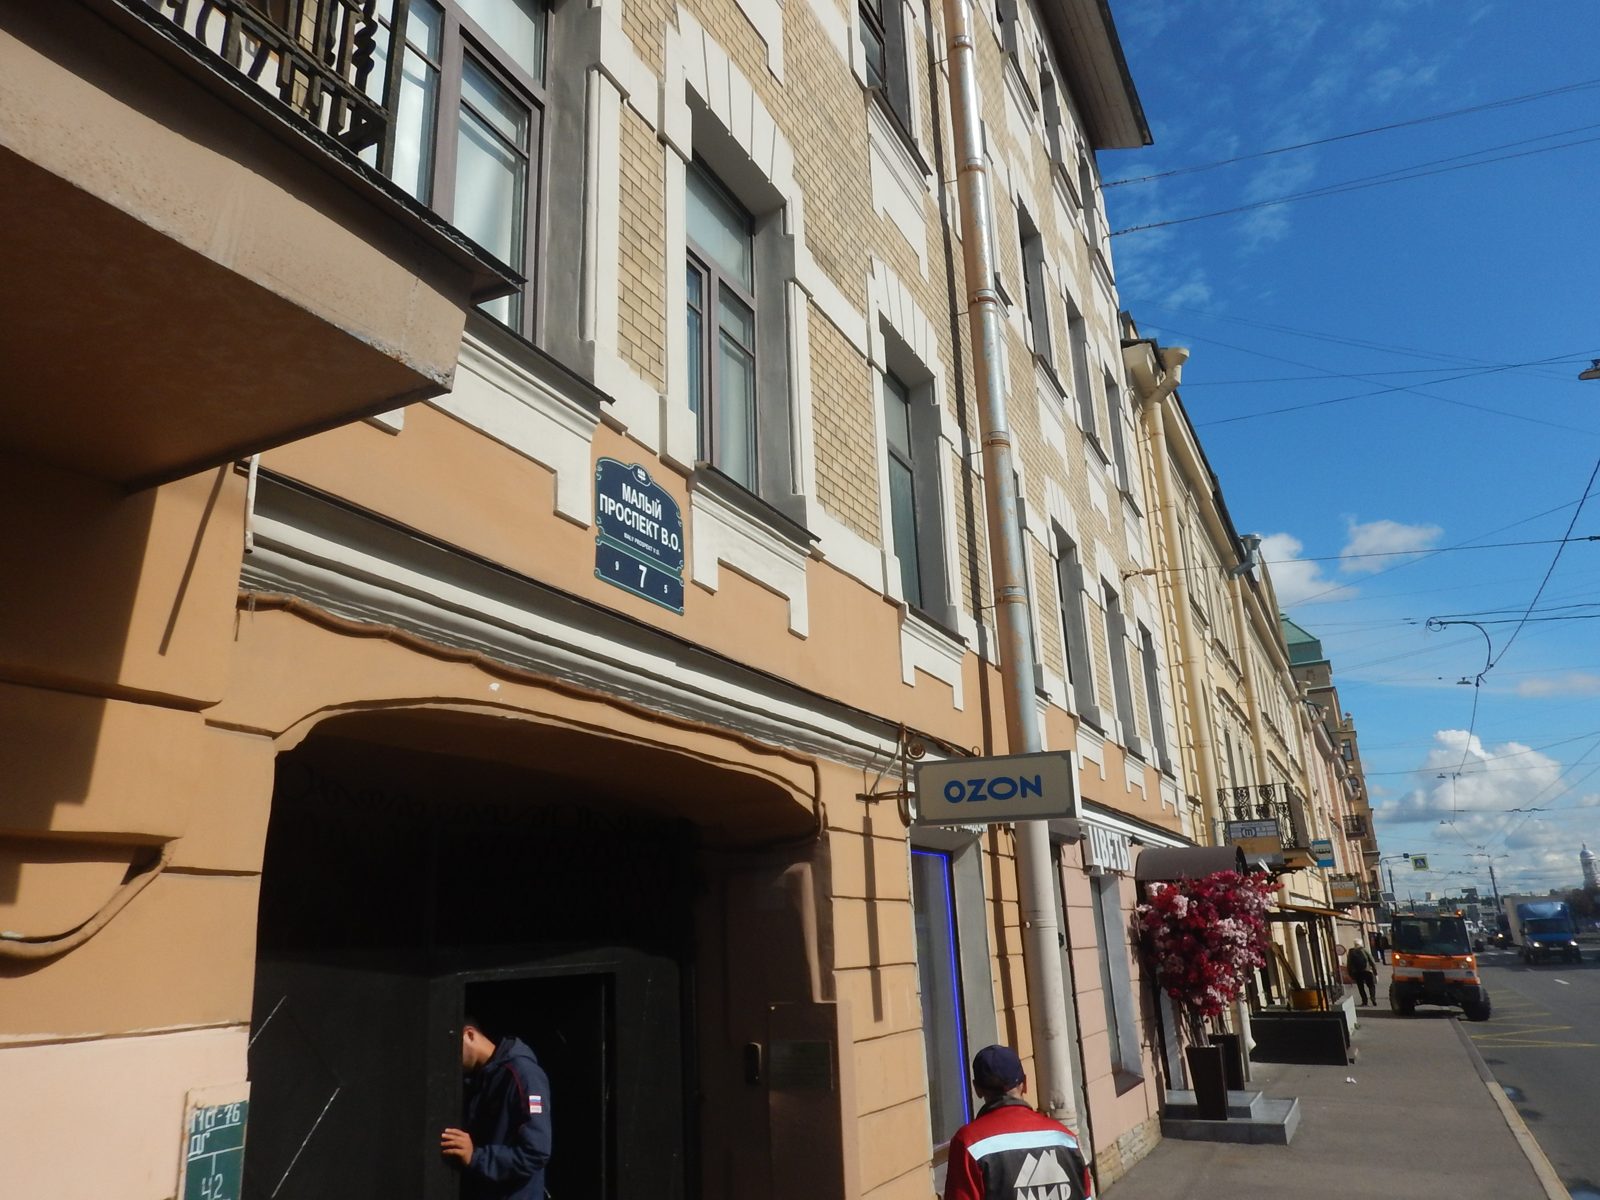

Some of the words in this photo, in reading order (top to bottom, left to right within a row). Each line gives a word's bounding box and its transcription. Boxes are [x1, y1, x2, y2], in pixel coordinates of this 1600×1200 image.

[600, 494, 659, 540] ПРОСПЕКТ
[622, 483, 662, 520] МАЛЫЙ
[638, 564, 648, 588] 7
[663, 584, 668, 594] 5
[944, 775, 1042, 803] OZON
[1088, 825, 1132, 875] ЦВЕТЫ
